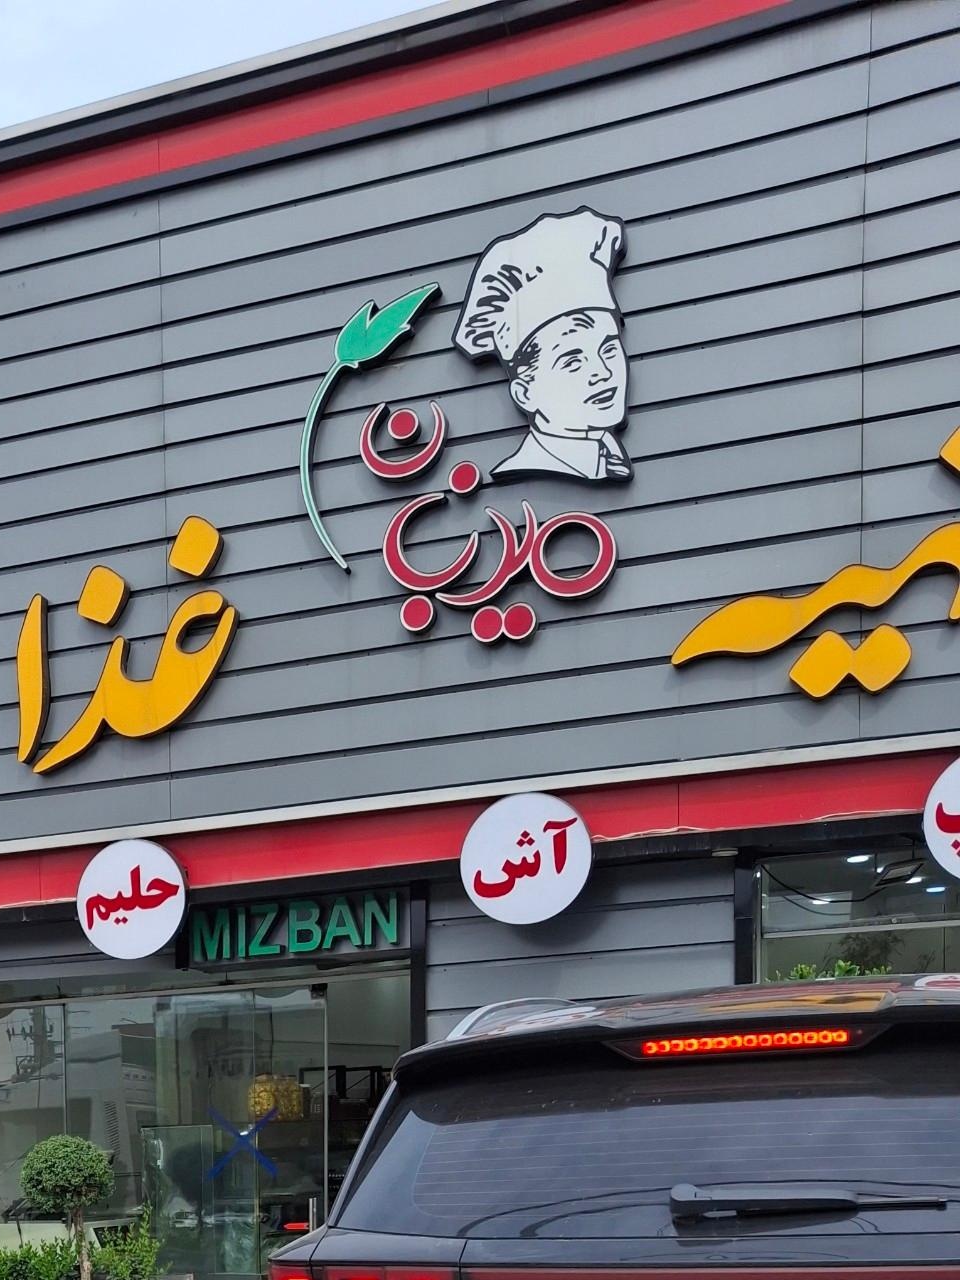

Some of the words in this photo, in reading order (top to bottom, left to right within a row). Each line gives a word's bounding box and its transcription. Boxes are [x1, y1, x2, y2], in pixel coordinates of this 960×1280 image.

[16, 515, 238, 774] غذا
[473, 817, 577, 898] آش
[85, 864, 180, 930] حلیم
[193, 893, 399, 960] MIZBAN
